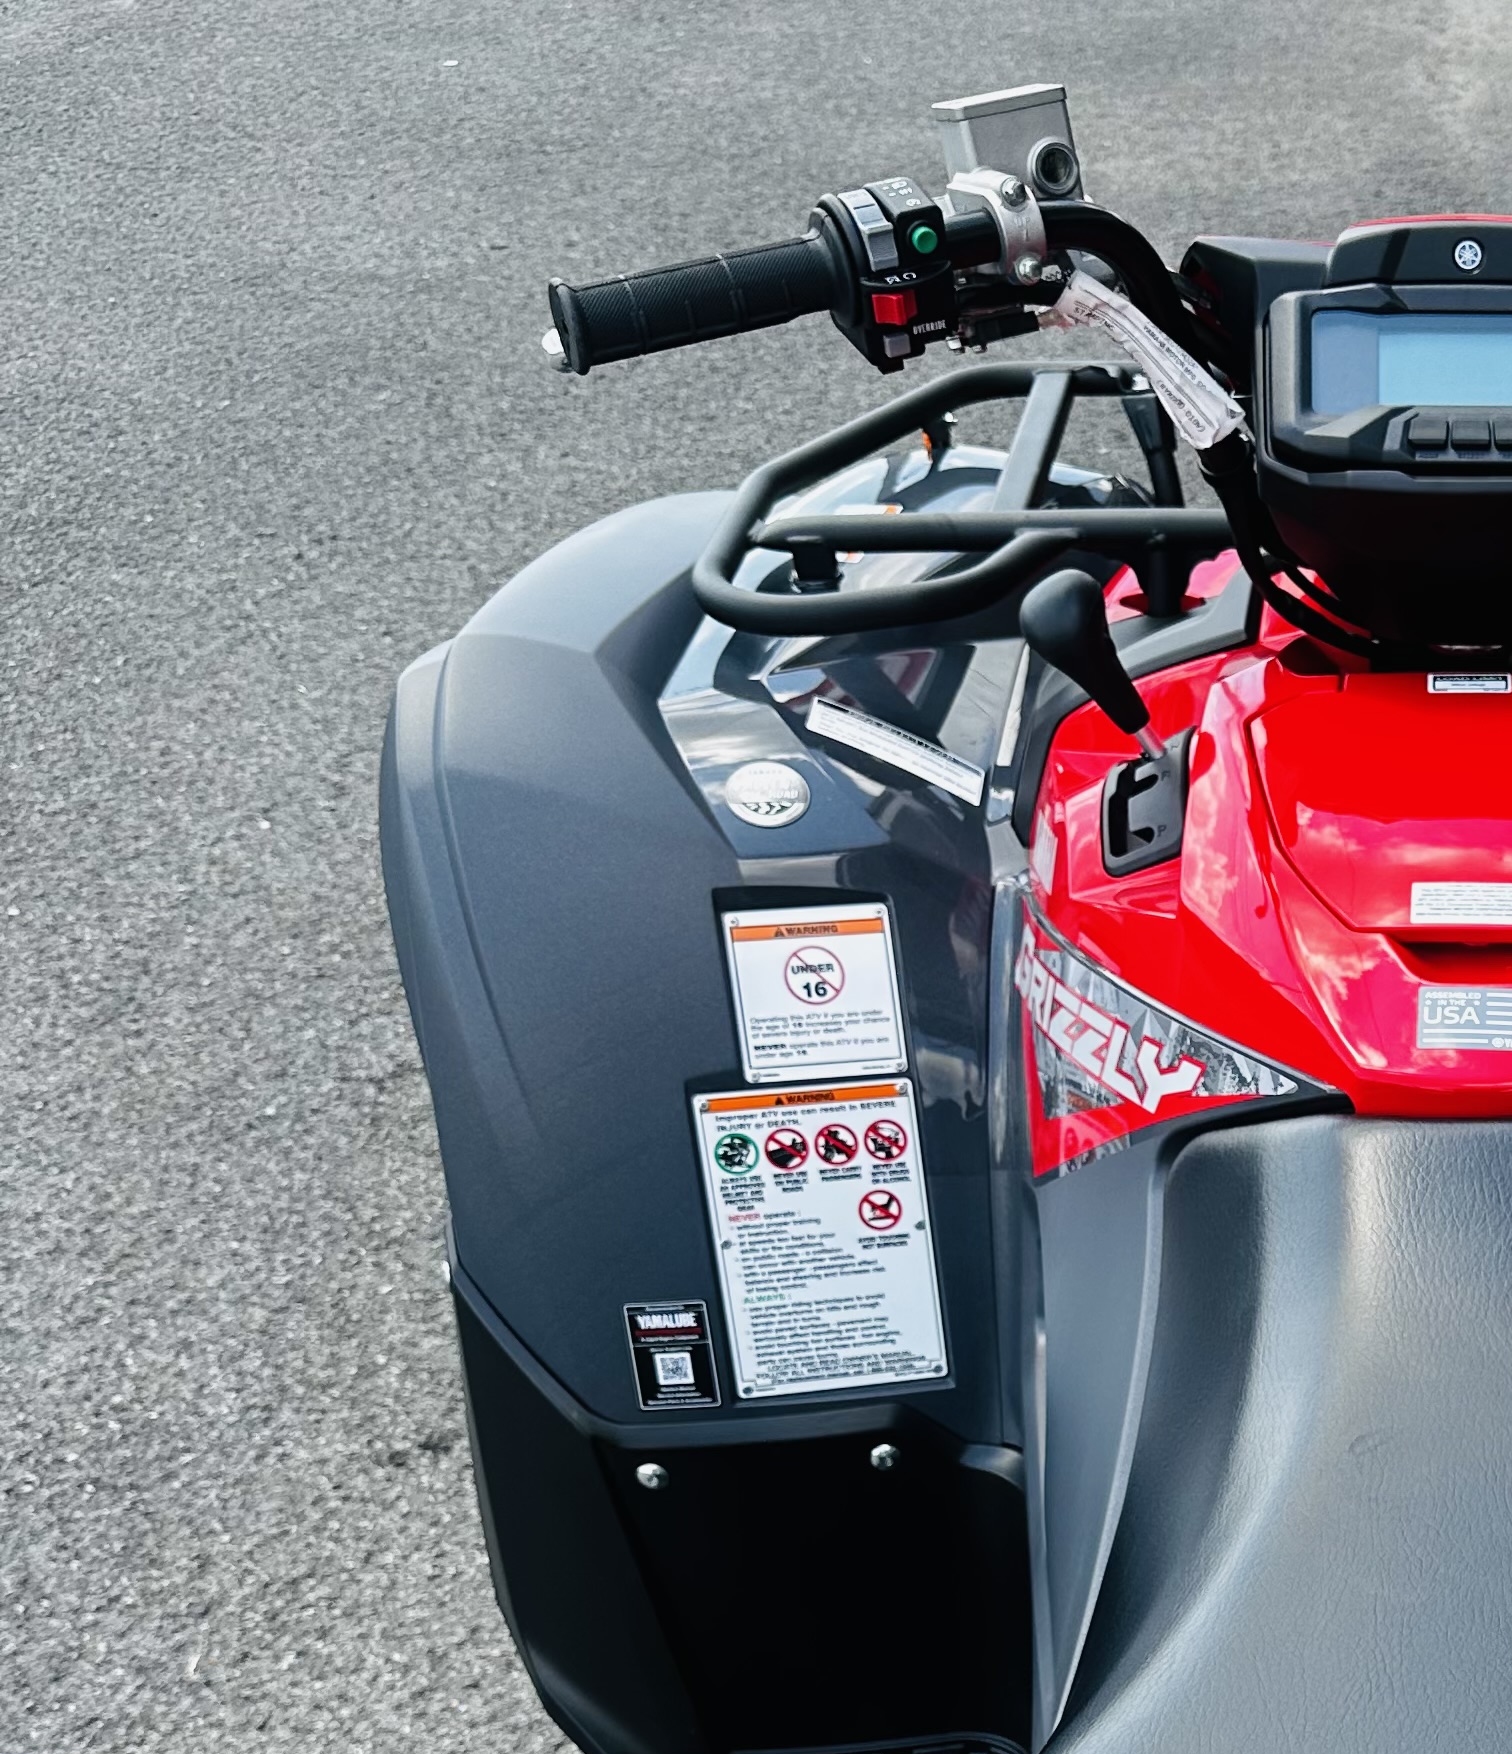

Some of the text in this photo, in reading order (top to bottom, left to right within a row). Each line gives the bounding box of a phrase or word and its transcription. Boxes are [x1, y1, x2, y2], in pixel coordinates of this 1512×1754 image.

[912, 320, 946, 335] OVERRIDE
[785, 924, 838, 935] WARNING
[790, 963, 834, 974] UNDER
[802, 981, 828, 998] 16
[1423, 1006, 1480, 1024] USA
[786, 1091, 835, 1103] WARNING
[714, 1112, 758, 1123] Improper
[728, 1213, 760, 1222] NEVER
[635, 1312, 698, 1329] YAMALUBE
